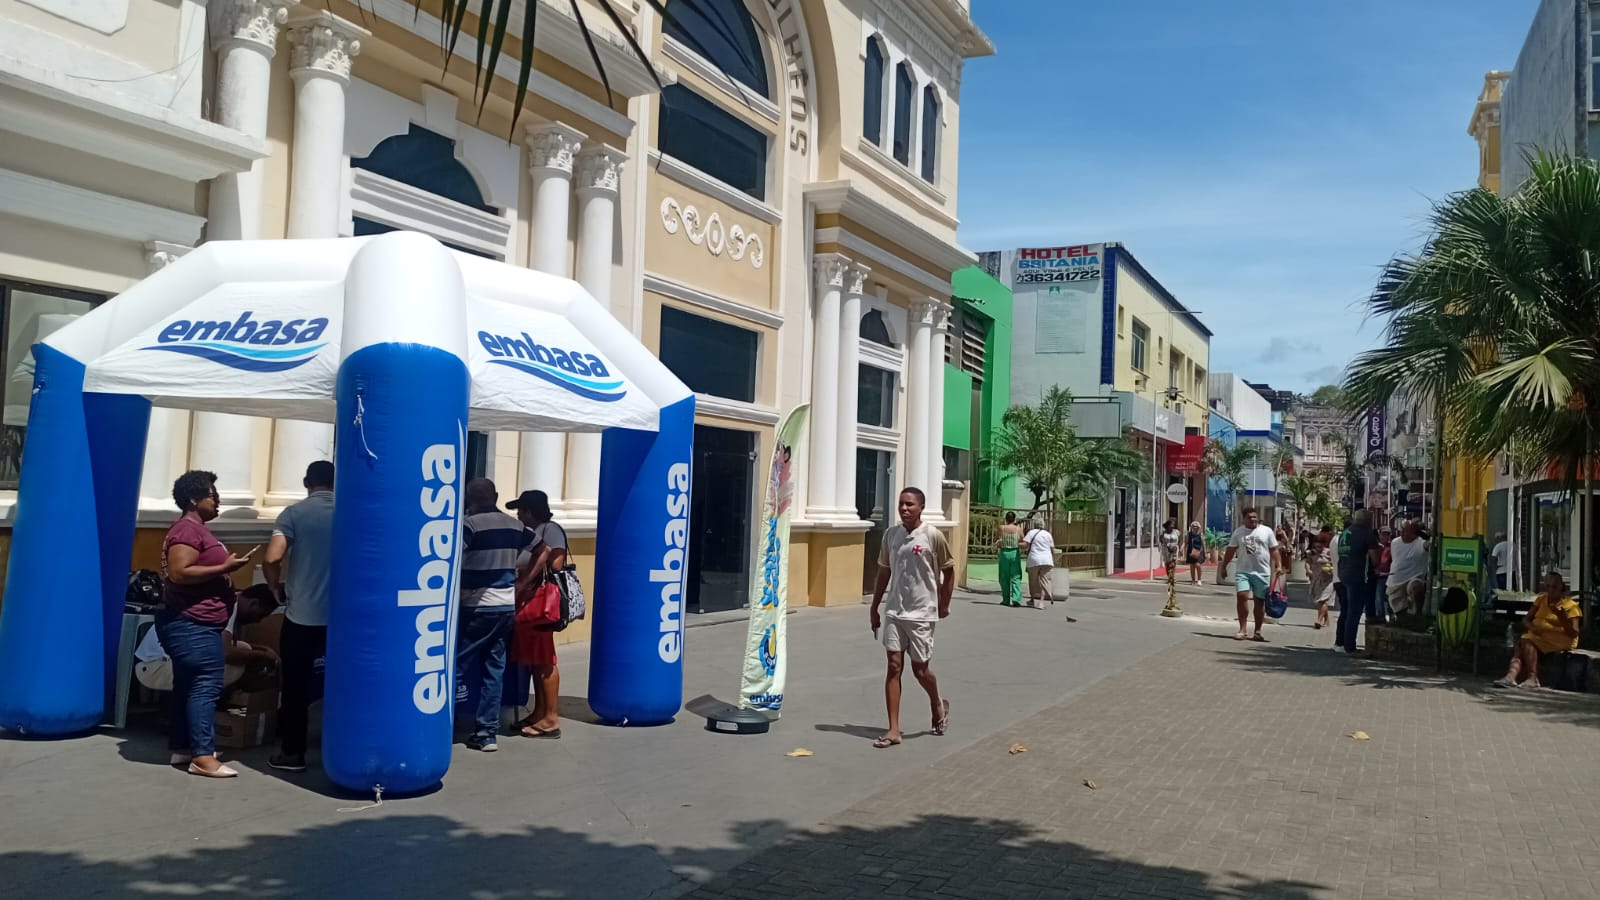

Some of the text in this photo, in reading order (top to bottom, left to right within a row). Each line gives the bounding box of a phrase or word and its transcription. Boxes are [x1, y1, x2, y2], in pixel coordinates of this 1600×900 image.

[1021, 245, 1098, 260] HOTEL
[1024, 270, 1100, 282] 36341722
[158, 311, 329, 345] embasa
[477, 331, 610, 377] embasa
[397, 444, 456, 714] embasa
[649, 462, 689, 664] embasa
